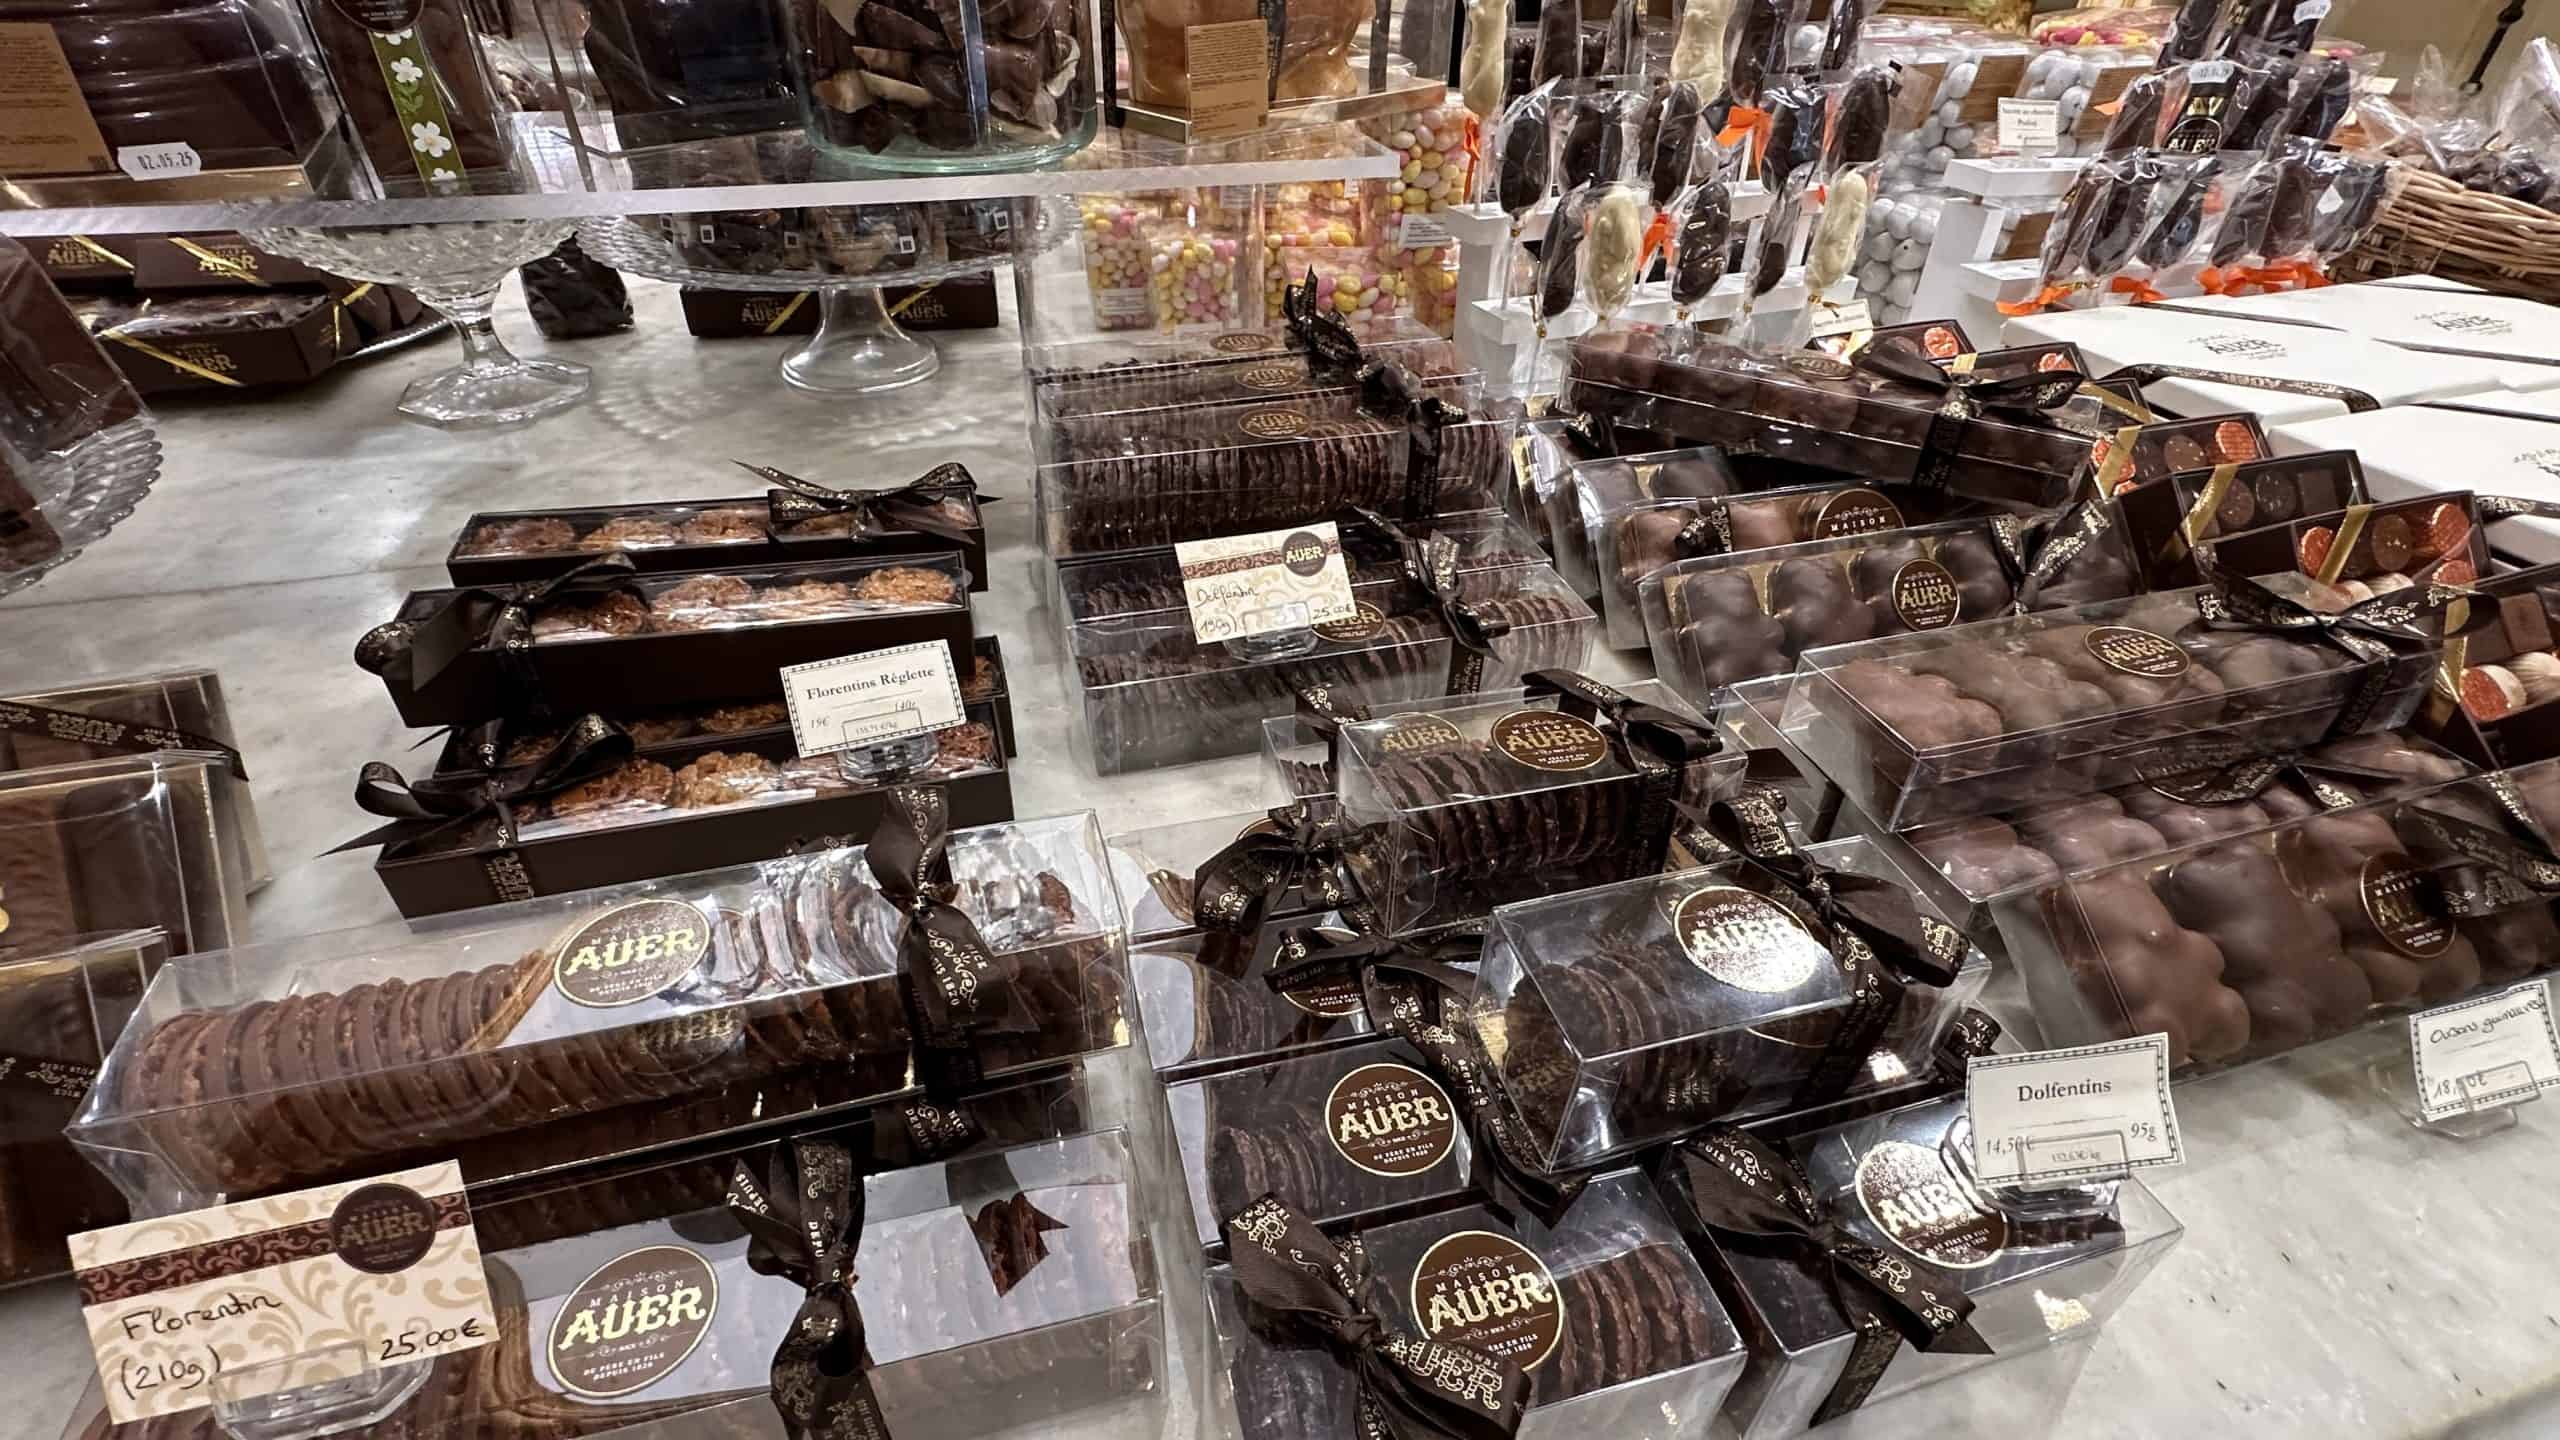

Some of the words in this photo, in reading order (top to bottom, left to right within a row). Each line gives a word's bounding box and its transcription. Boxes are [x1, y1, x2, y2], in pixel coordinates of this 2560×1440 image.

[1830, 515, 1886, 532] MAISON
[1285, 545, 1324, 564] AUER
[1900, 583, 1957, 609] AUER
[806, 678, 877, 700] Florentins
[880, 668, 936, 686] Réglette
[1381, 728, 1459, 752] AUER
[1505, 728, 1600, 751] AUER
[563, 926, 701, 977] AUER
[1347, 1088, 1420, 1111] MAISON
[2018, 1077, 2113, 1102] Dolfentins
[1338, 1095, 1450, 1144] AUER
[2130, 1122, 2157, 1143] 95g
[1728, 1161, 1756, 1187] 1820
[735, 1172, 769, 1216] DEPUIS
[339, 1211, 431, 1249] AUER
[589, 1278, 685, 1308] MAISON
[1333, 1263, 1356, 1298] NICE
[1435, 1263, 1517, 1293] MAISON
[121, 1290, 283, 1341] Florentin
[558, 1285, 707, 1351] AUER
[1429, 1271, 1553, 1335] AUER
[120, 1344, 223, 1401] (210g)
[1389, 1333, 1504, 1411] AUER
